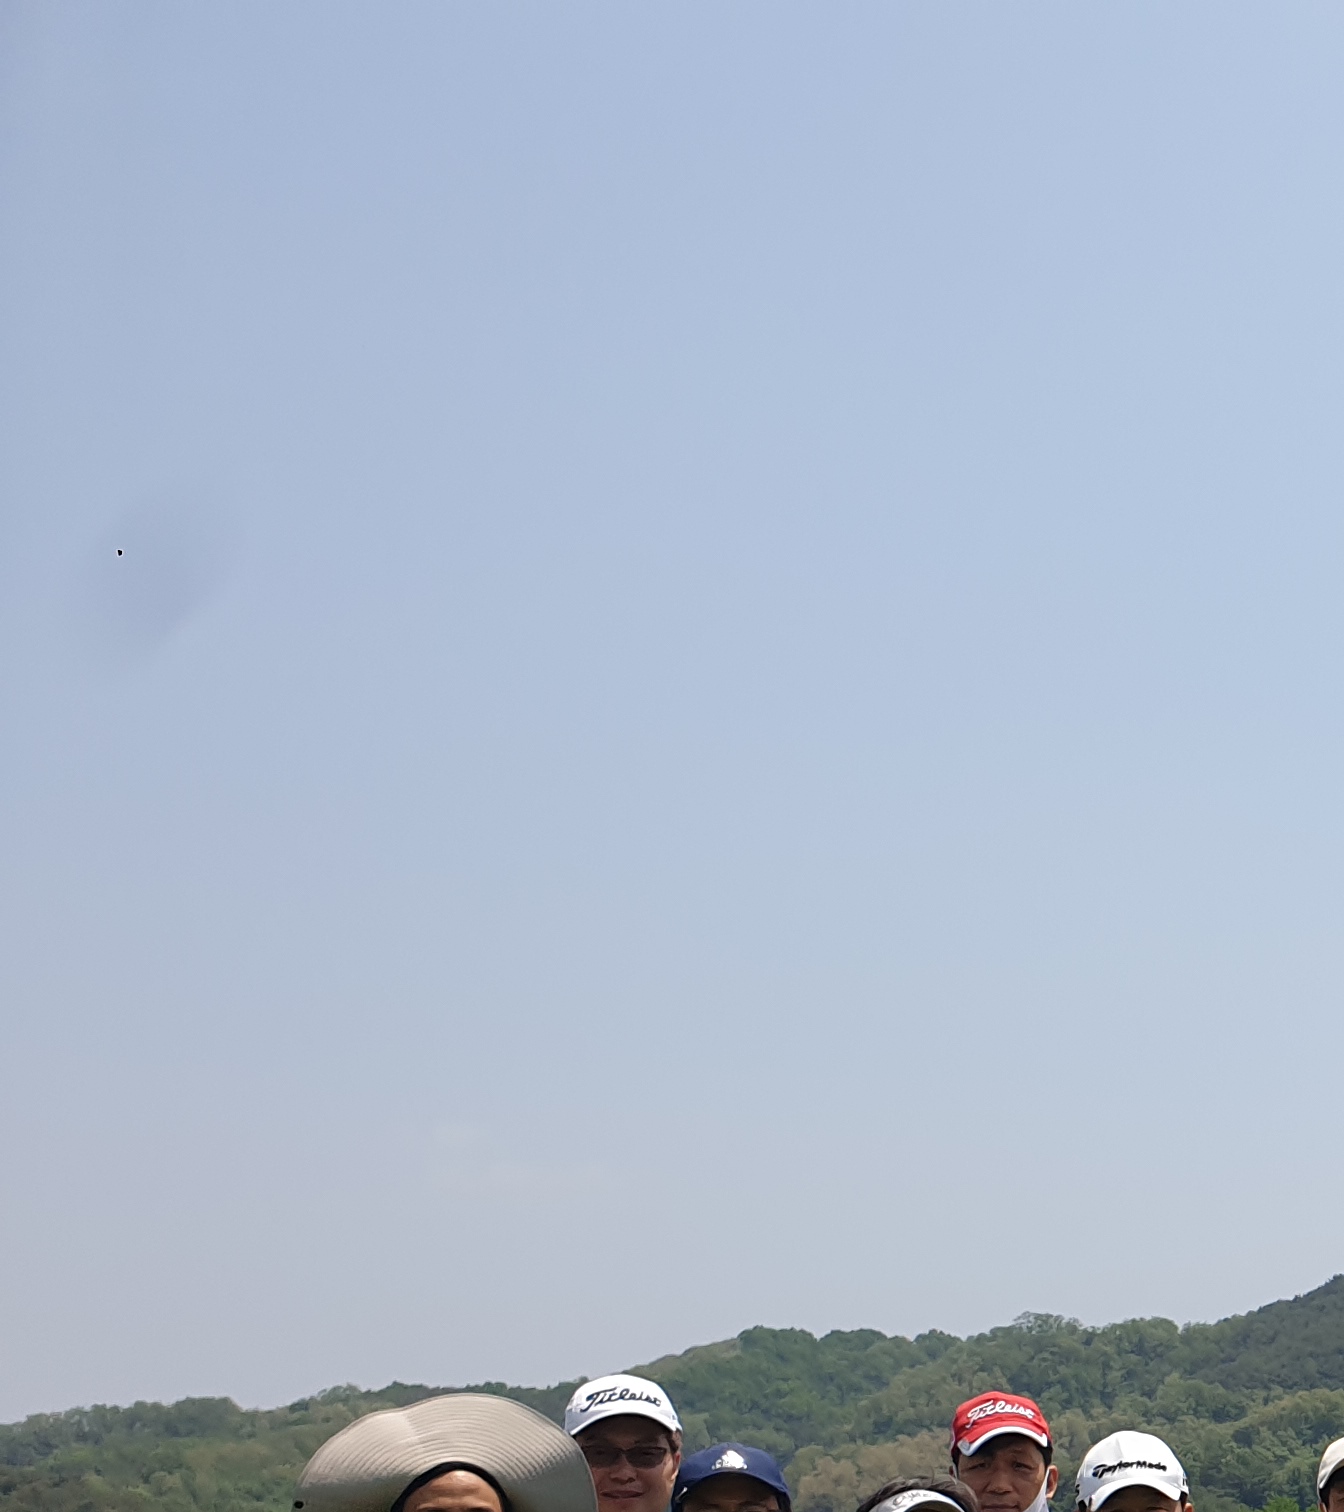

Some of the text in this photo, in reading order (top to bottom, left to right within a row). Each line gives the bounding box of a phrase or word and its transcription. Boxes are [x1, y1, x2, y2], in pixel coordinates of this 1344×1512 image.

[581, 1387, 661, 1412] Titleist
[965, 1400, 1035, 1428] Titleist
[1092, 1461, 1167, 1478] TaylorMade
